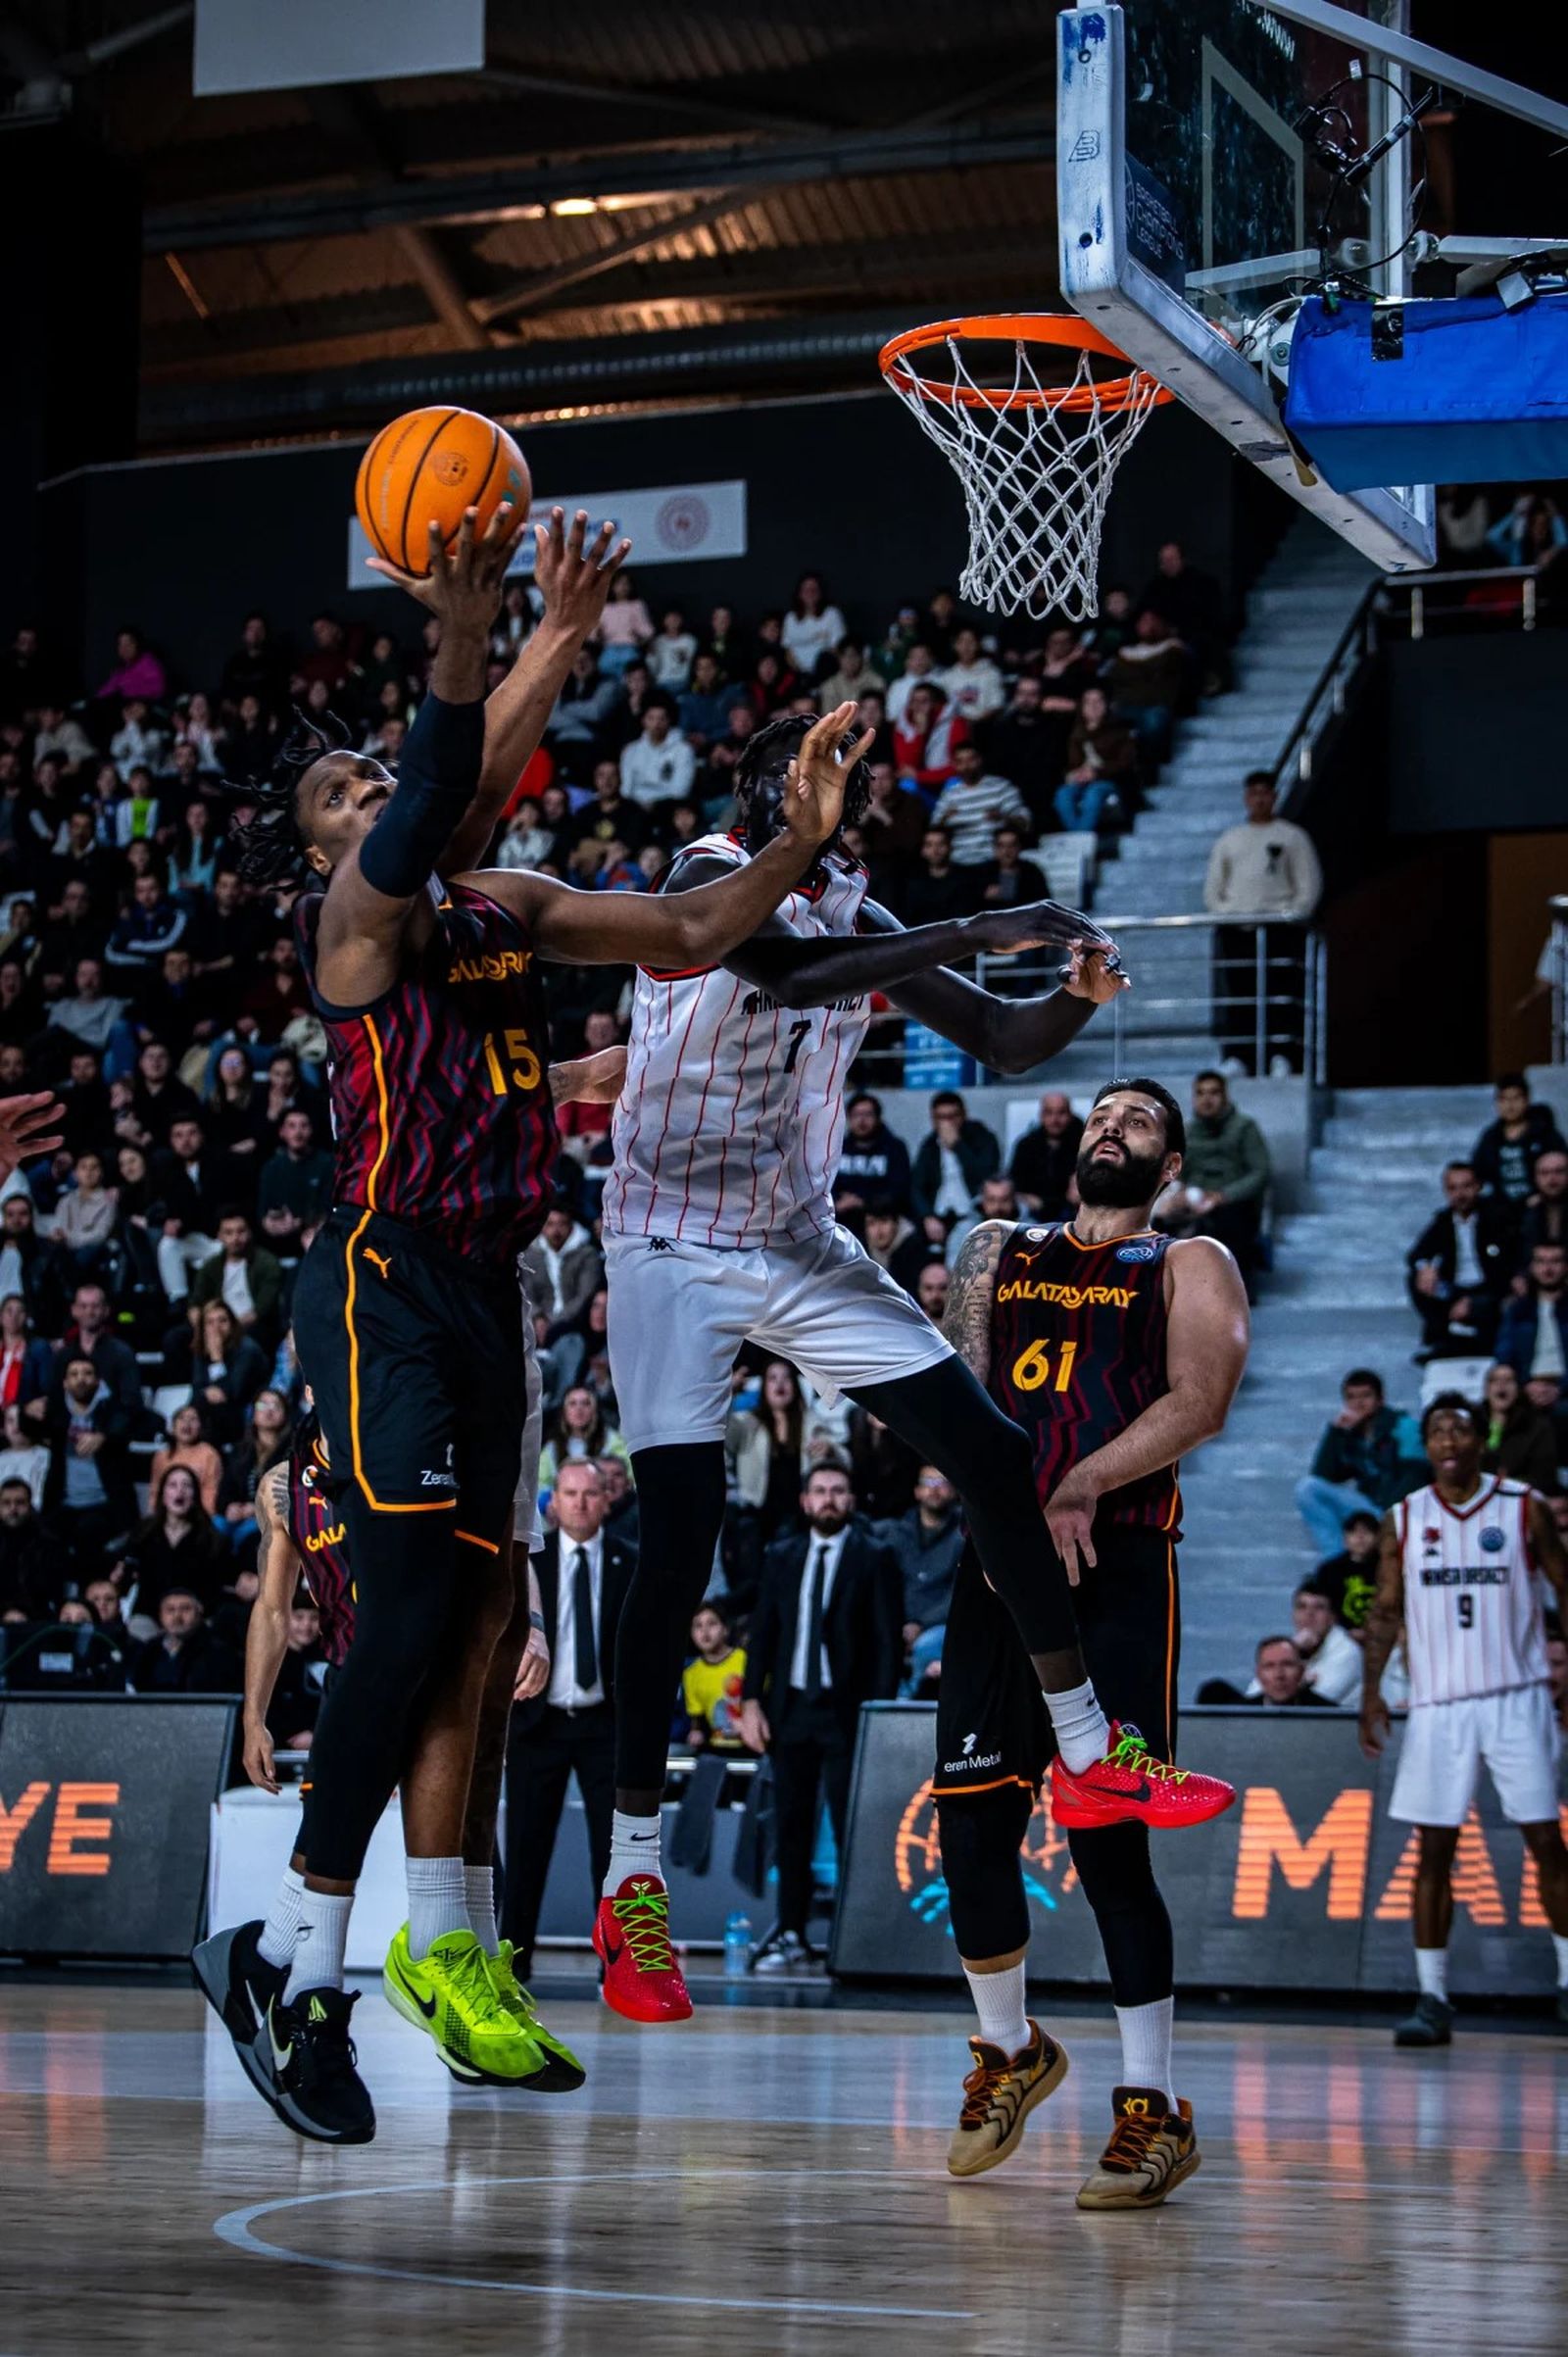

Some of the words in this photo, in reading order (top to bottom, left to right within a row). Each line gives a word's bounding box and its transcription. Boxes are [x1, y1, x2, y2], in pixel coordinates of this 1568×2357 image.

[483, 1028, 542, 1096] 15
[783, 1018, 812, 1074] 7
[997, 1280, 1141, 1309] GALATASARAY
[1011, 1338, 1078, 1393] 61
[1456, 1593, 1474, 1630] 9
[968, 1750, 1002, 1769] Metal
